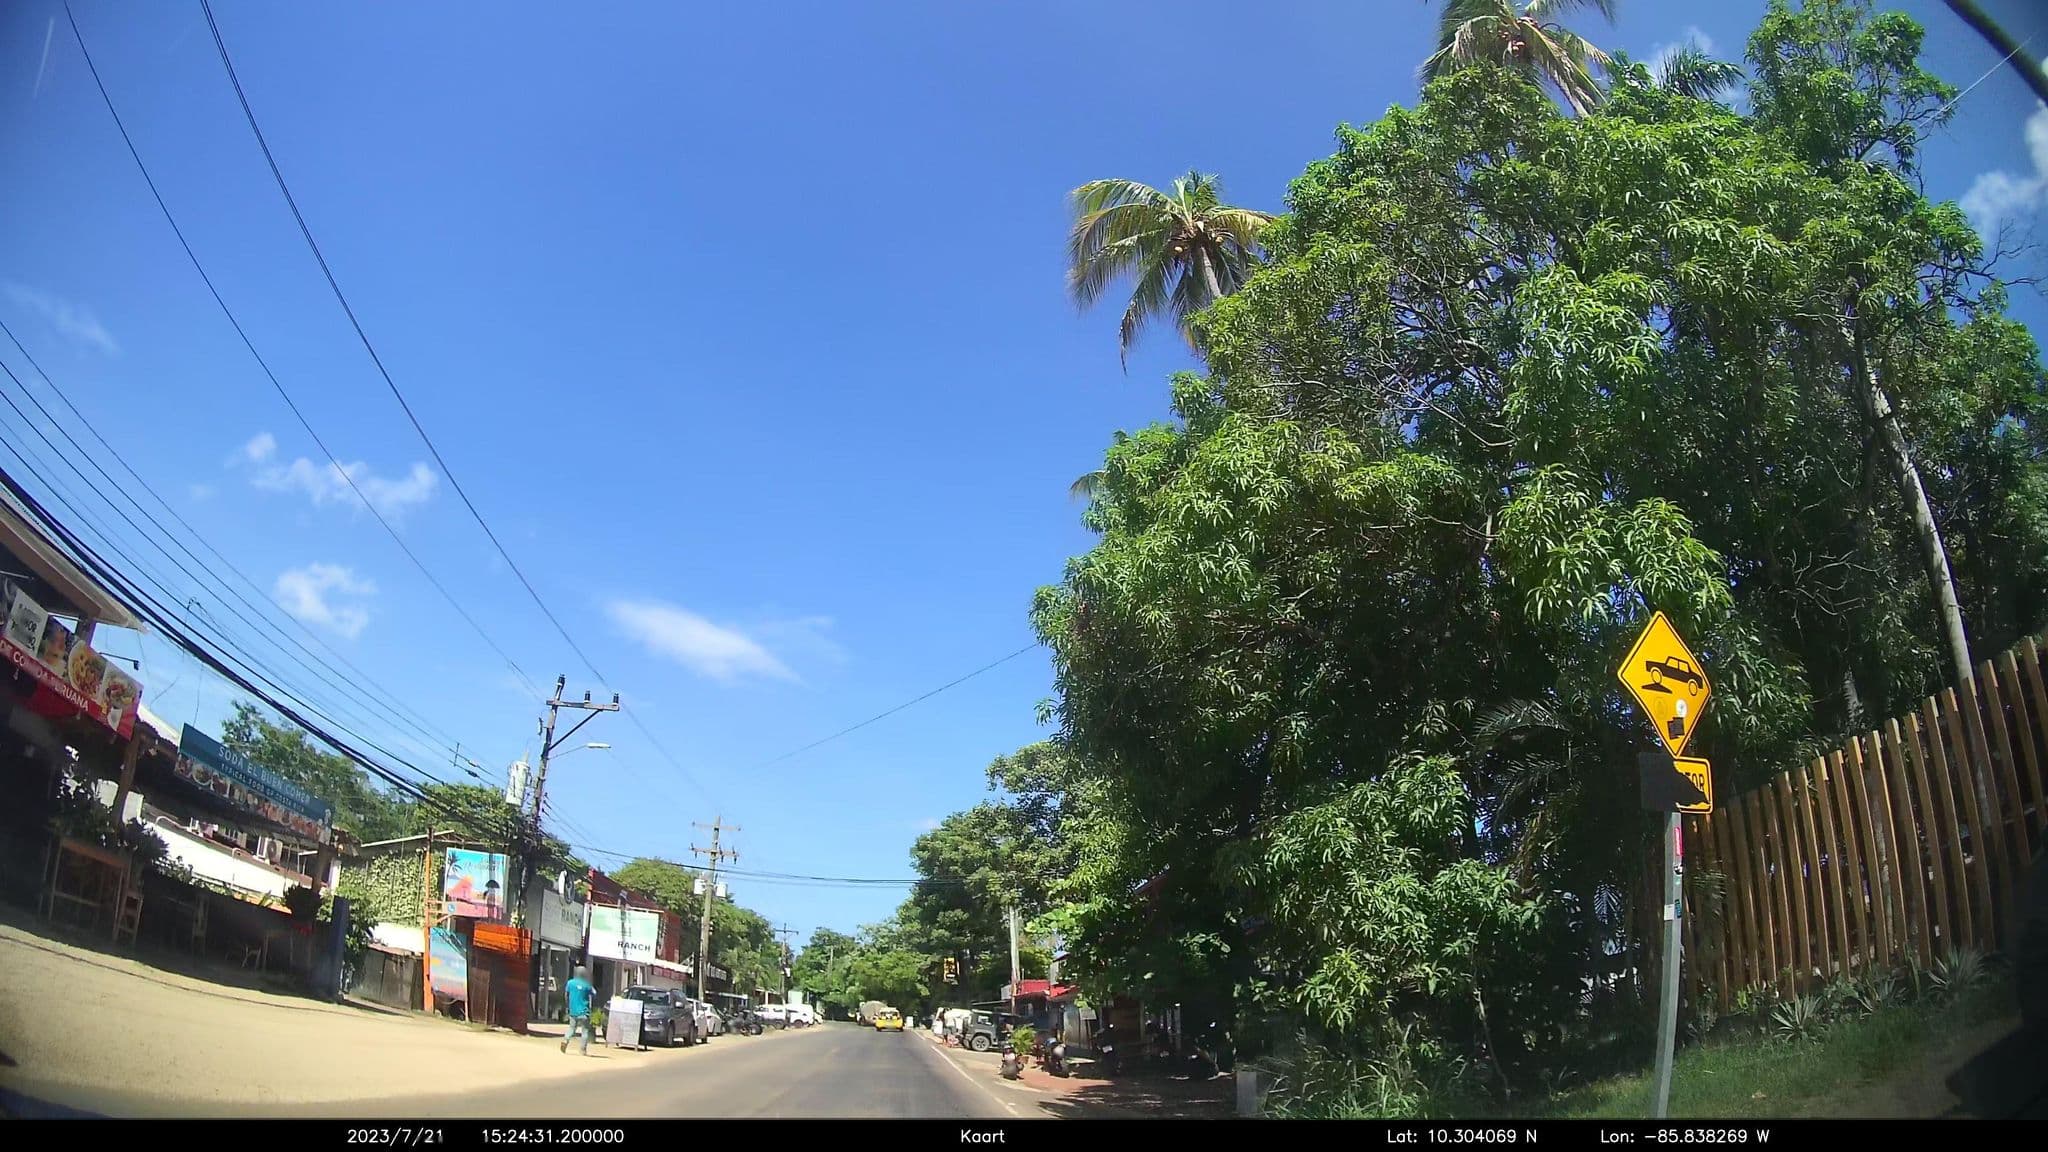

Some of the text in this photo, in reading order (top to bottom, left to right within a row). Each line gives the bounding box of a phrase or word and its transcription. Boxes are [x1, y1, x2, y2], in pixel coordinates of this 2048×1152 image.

[218, 746, 244, 769] SODA
[247, 763, 258, 777] EL
[617, 940, 651, 953] RANCH
